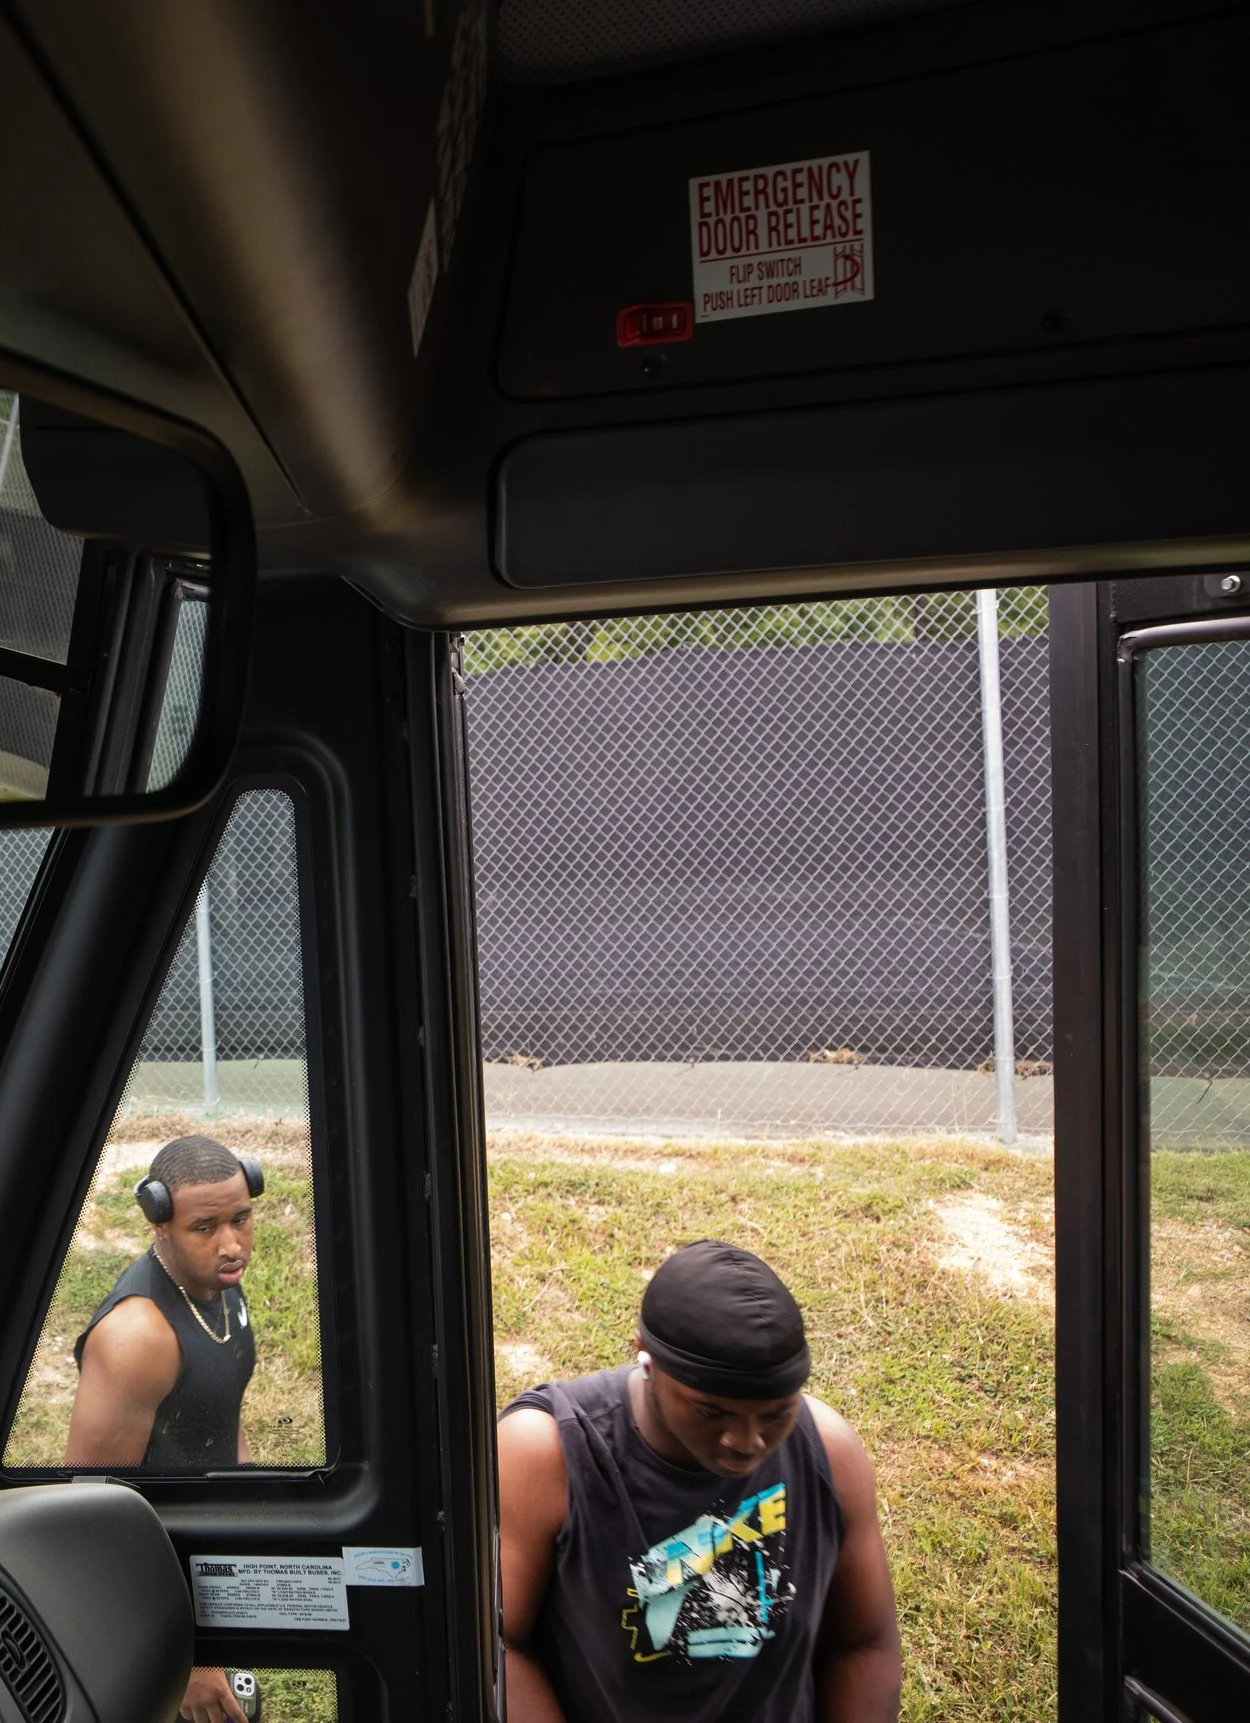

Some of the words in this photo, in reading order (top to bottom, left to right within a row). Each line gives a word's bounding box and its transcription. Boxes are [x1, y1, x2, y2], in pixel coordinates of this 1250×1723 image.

[698, 158, 860, 219] EMERGENCY
[698, 210, 758, 258] DOOR
[767, 198, 864, 249] RELEASE
[703, 289, 734, 312] PUSH
[737, 285, 763, 308] LEFT
[767, 281, 800, 304] DOOR
[803, 276, 831, 298] LEAF
[729, 262, 754, 285] FLIP
[757, 256, 803, 280] SWITCH
[666, 1482, 786, 1585] NKE
[196, 1562, 237, 1573] Thomas
